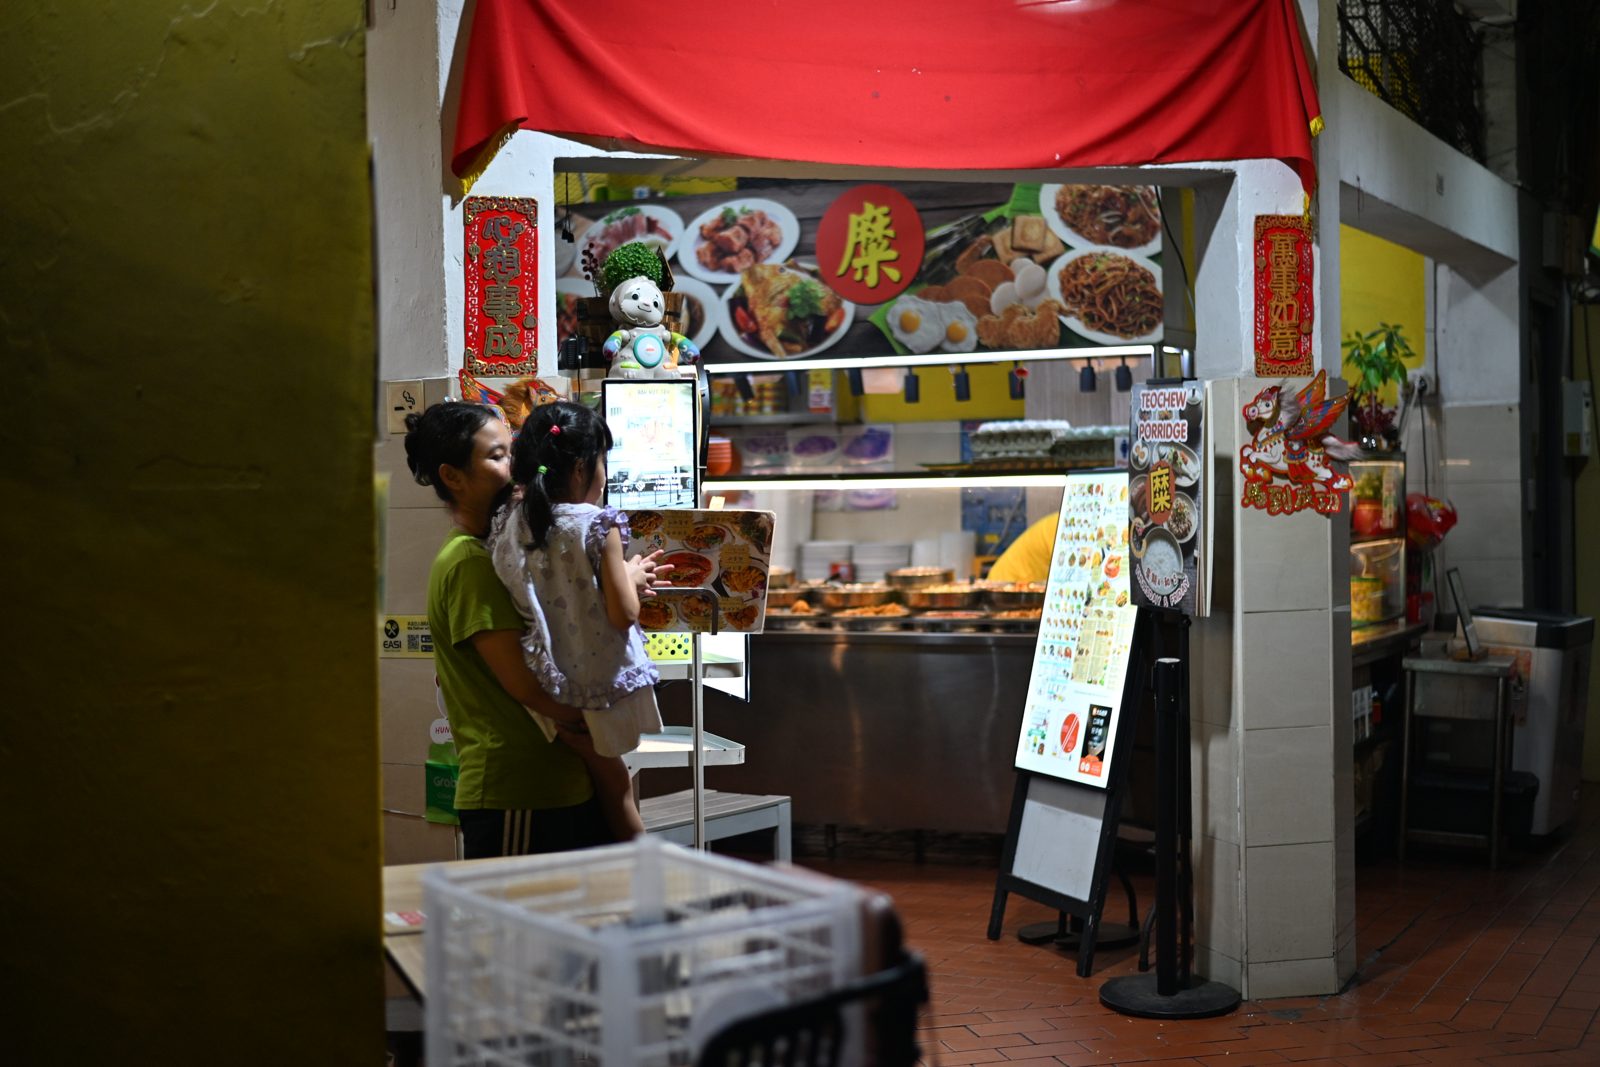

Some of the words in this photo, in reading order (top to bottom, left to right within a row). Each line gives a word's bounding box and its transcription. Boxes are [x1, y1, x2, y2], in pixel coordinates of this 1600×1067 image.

[482, 215, 524, 359] 心想事成
[1268, 232, 1301, 361] 萬事如意
[1139, 388, 1187, 411] TEOCHEW
[1138, 420, 1188, 442] PORRIDGE
[1169, 574, 1190, 606] FRIDAY
[383, 640, 402, 649] EASI
